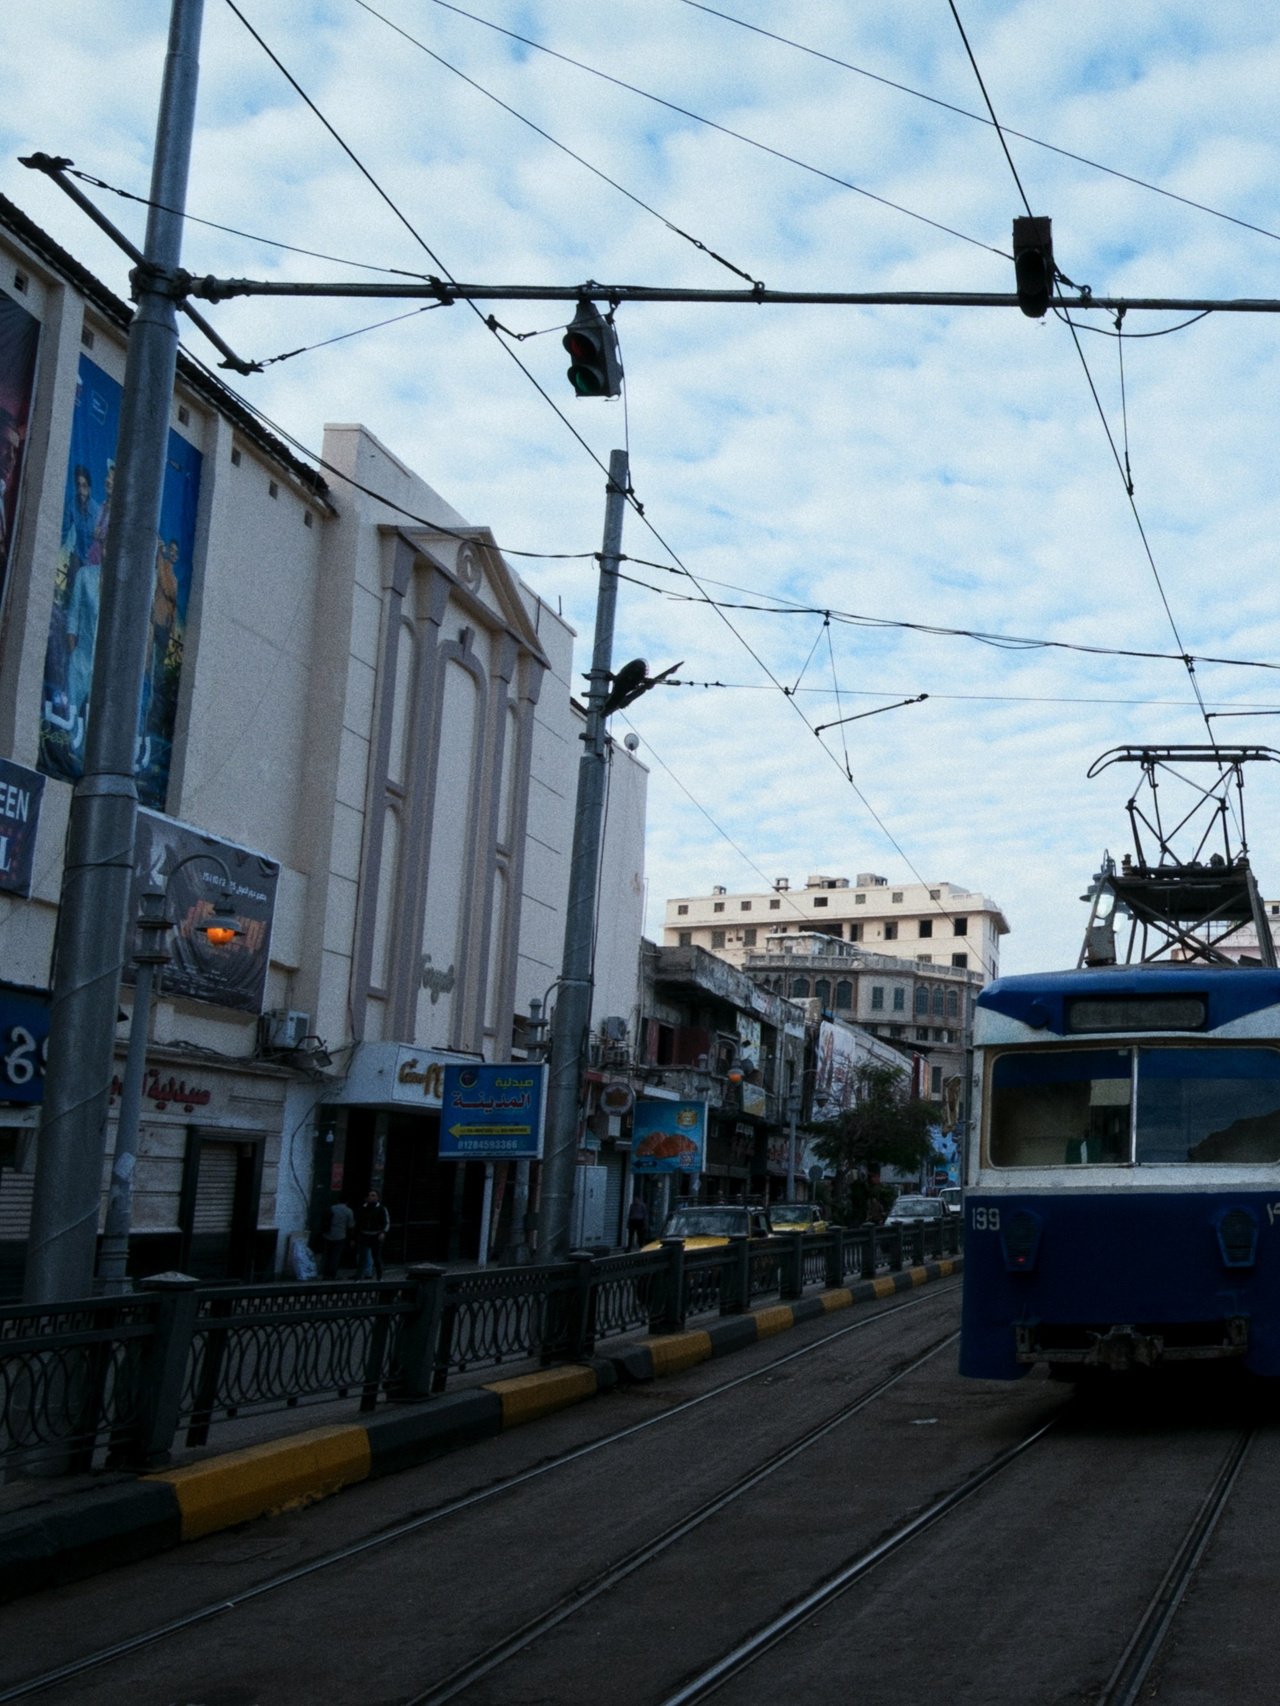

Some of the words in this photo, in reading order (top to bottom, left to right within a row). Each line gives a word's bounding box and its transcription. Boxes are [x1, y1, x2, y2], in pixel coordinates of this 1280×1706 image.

[147, 1068, 211, 1114] صيدلية
[495, 1078, 534, 1089] صيدلية
[451, 1090, 532, 1115] المدينة
[972, 1207, 1001, 1231] 199
